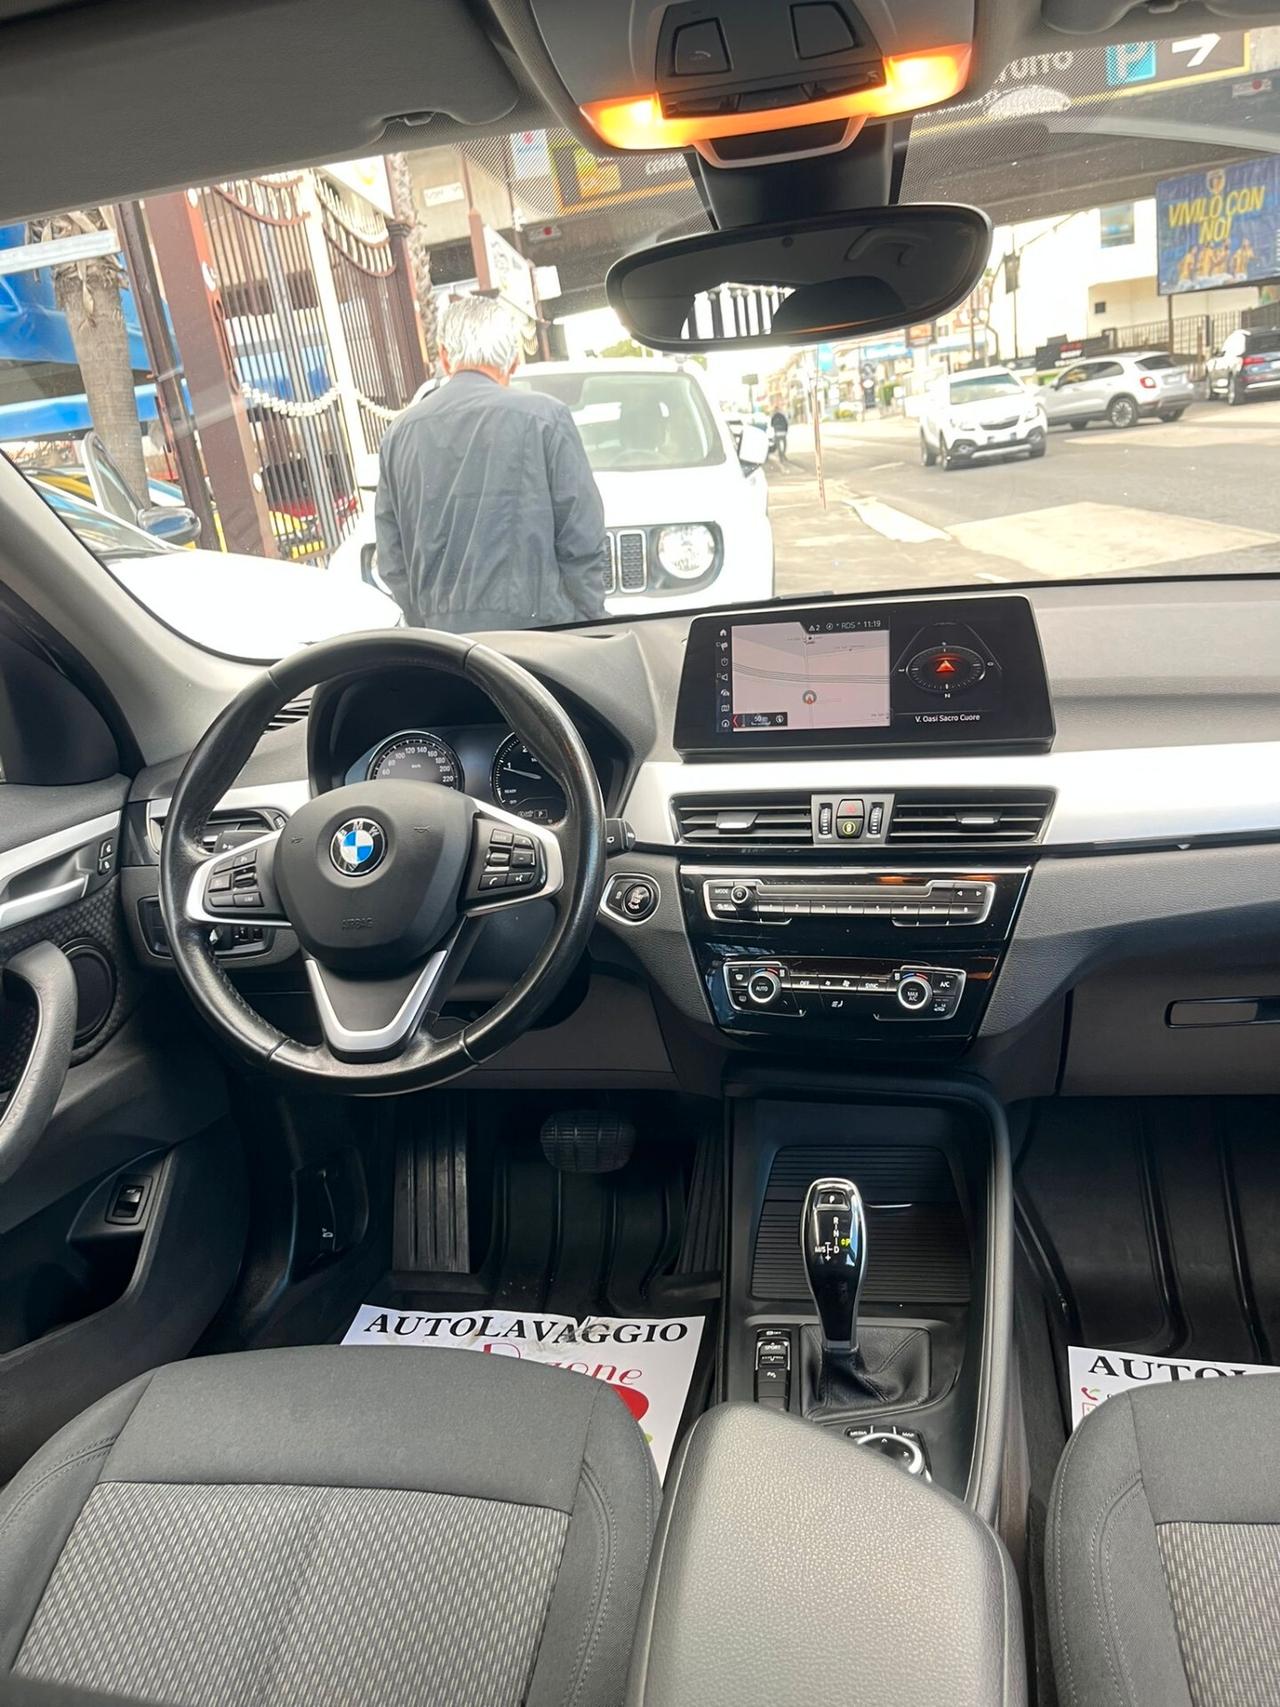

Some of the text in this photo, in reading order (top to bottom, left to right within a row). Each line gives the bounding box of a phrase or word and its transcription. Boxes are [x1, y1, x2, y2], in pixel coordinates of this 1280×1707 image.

[1225, 186, 1265, 216] CON
[863, 620, 881, 628] 11:19
[922, 715, 939, 723] Oasi
[336, 820, 380, 843] BMW
[829, 1195, 835, 1204] P
[833, 1216, 839, 1224] R
[833, 1245, 840, 1254] D
[363, 1313, 689, 1345] AUTOLAVAGGIO
